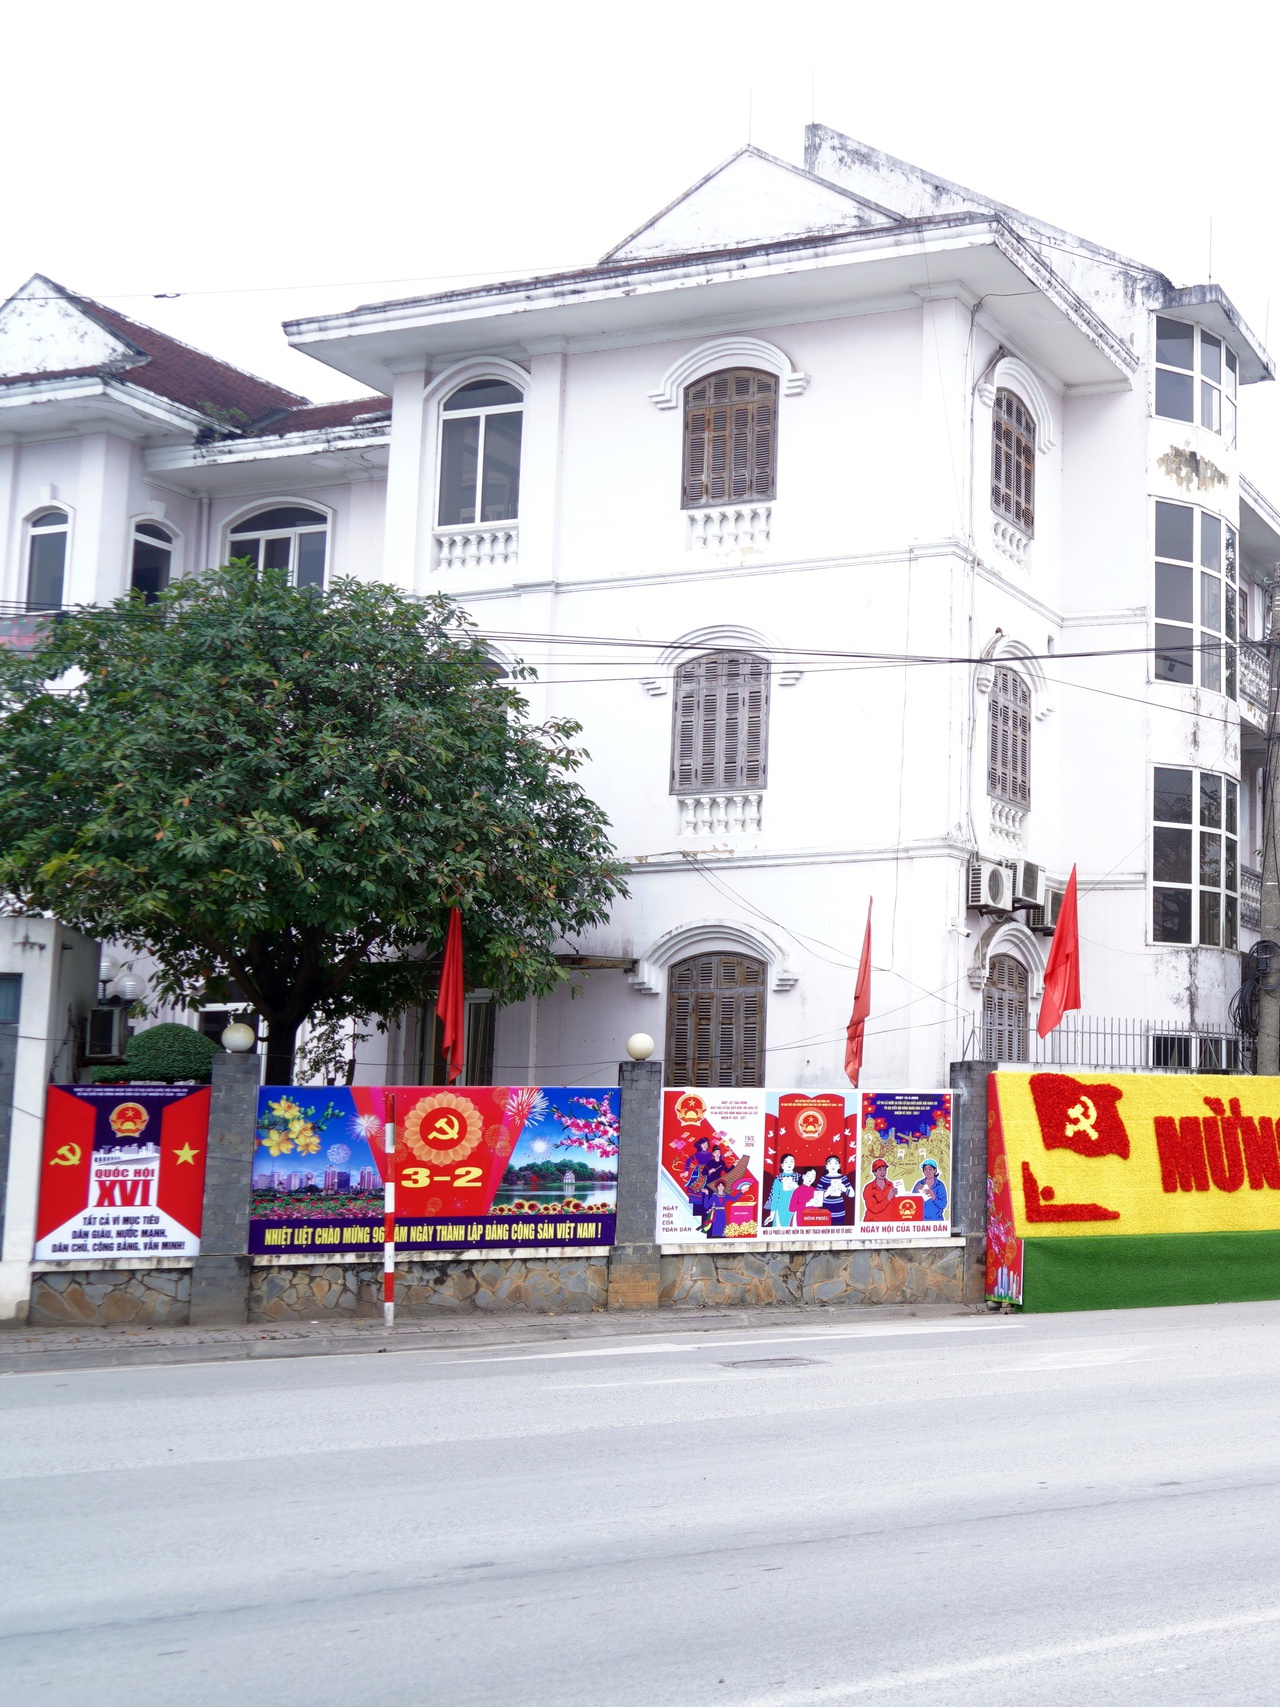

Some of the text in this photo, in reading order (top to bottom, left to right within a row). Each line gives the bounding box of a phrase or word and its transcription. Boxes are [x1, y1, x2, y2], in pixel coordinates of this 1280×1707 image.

[95, 1167, 155, 1179] QUỐC HỘI
[401, 1167, 483, 1188] 3-2
[93, 1179, 154, 1207] XVI
[83, 1214, 97, 1226] TẤT
[99, 1213, 109, 1226] CẢ
[122, 1215, 140, 1227] MỤC
[143, 1214, 160, 1225] TIÊU
[72, 1225, 167, 1240] DÂN GIÀU, NƯỚC MẠNH,
[264, 1226, 292, 1248] NHIỆT
[294, 1226, 313, 1247] LIỆT
[315, 1225, 341, 1244] CHÀO
[343, 1225, 370, 1244] MỪNG
[372, 1227, 385, 1243] 96
[394, 1224, 407, 1243] ĂM
[410, 1223, 434, 1242] NGÀY
[436, 1223, 465, 1241] THÀNH
[467, 1222, 483, 1243] LẬP
[485, 1221, 509, 1240] ĐẢNG
[511, 1221, 535, 1242] CỘNG
[537, 1220, 554, 1239] SẢN
[557, 1220, 575, 1241] VIỆT
[577, 1223, 596, 1239] NAM
[861, 1225, 879, 1233] NGÀY
[882, 1224, 894, 1234] HỘI
[896, 1222, 910, 1232] CỦA
[933, 1224, 948, 1232] DÂN
[52, 1243, 68, 1253] DÂN
[71, 1240, 89, 1253] CHỦ,
[92, 1242, 114, 1252] CÔNG
[116, 1240, 141, 1252] BẰNG,
[161, 1241, 185, 1250] MINH!
